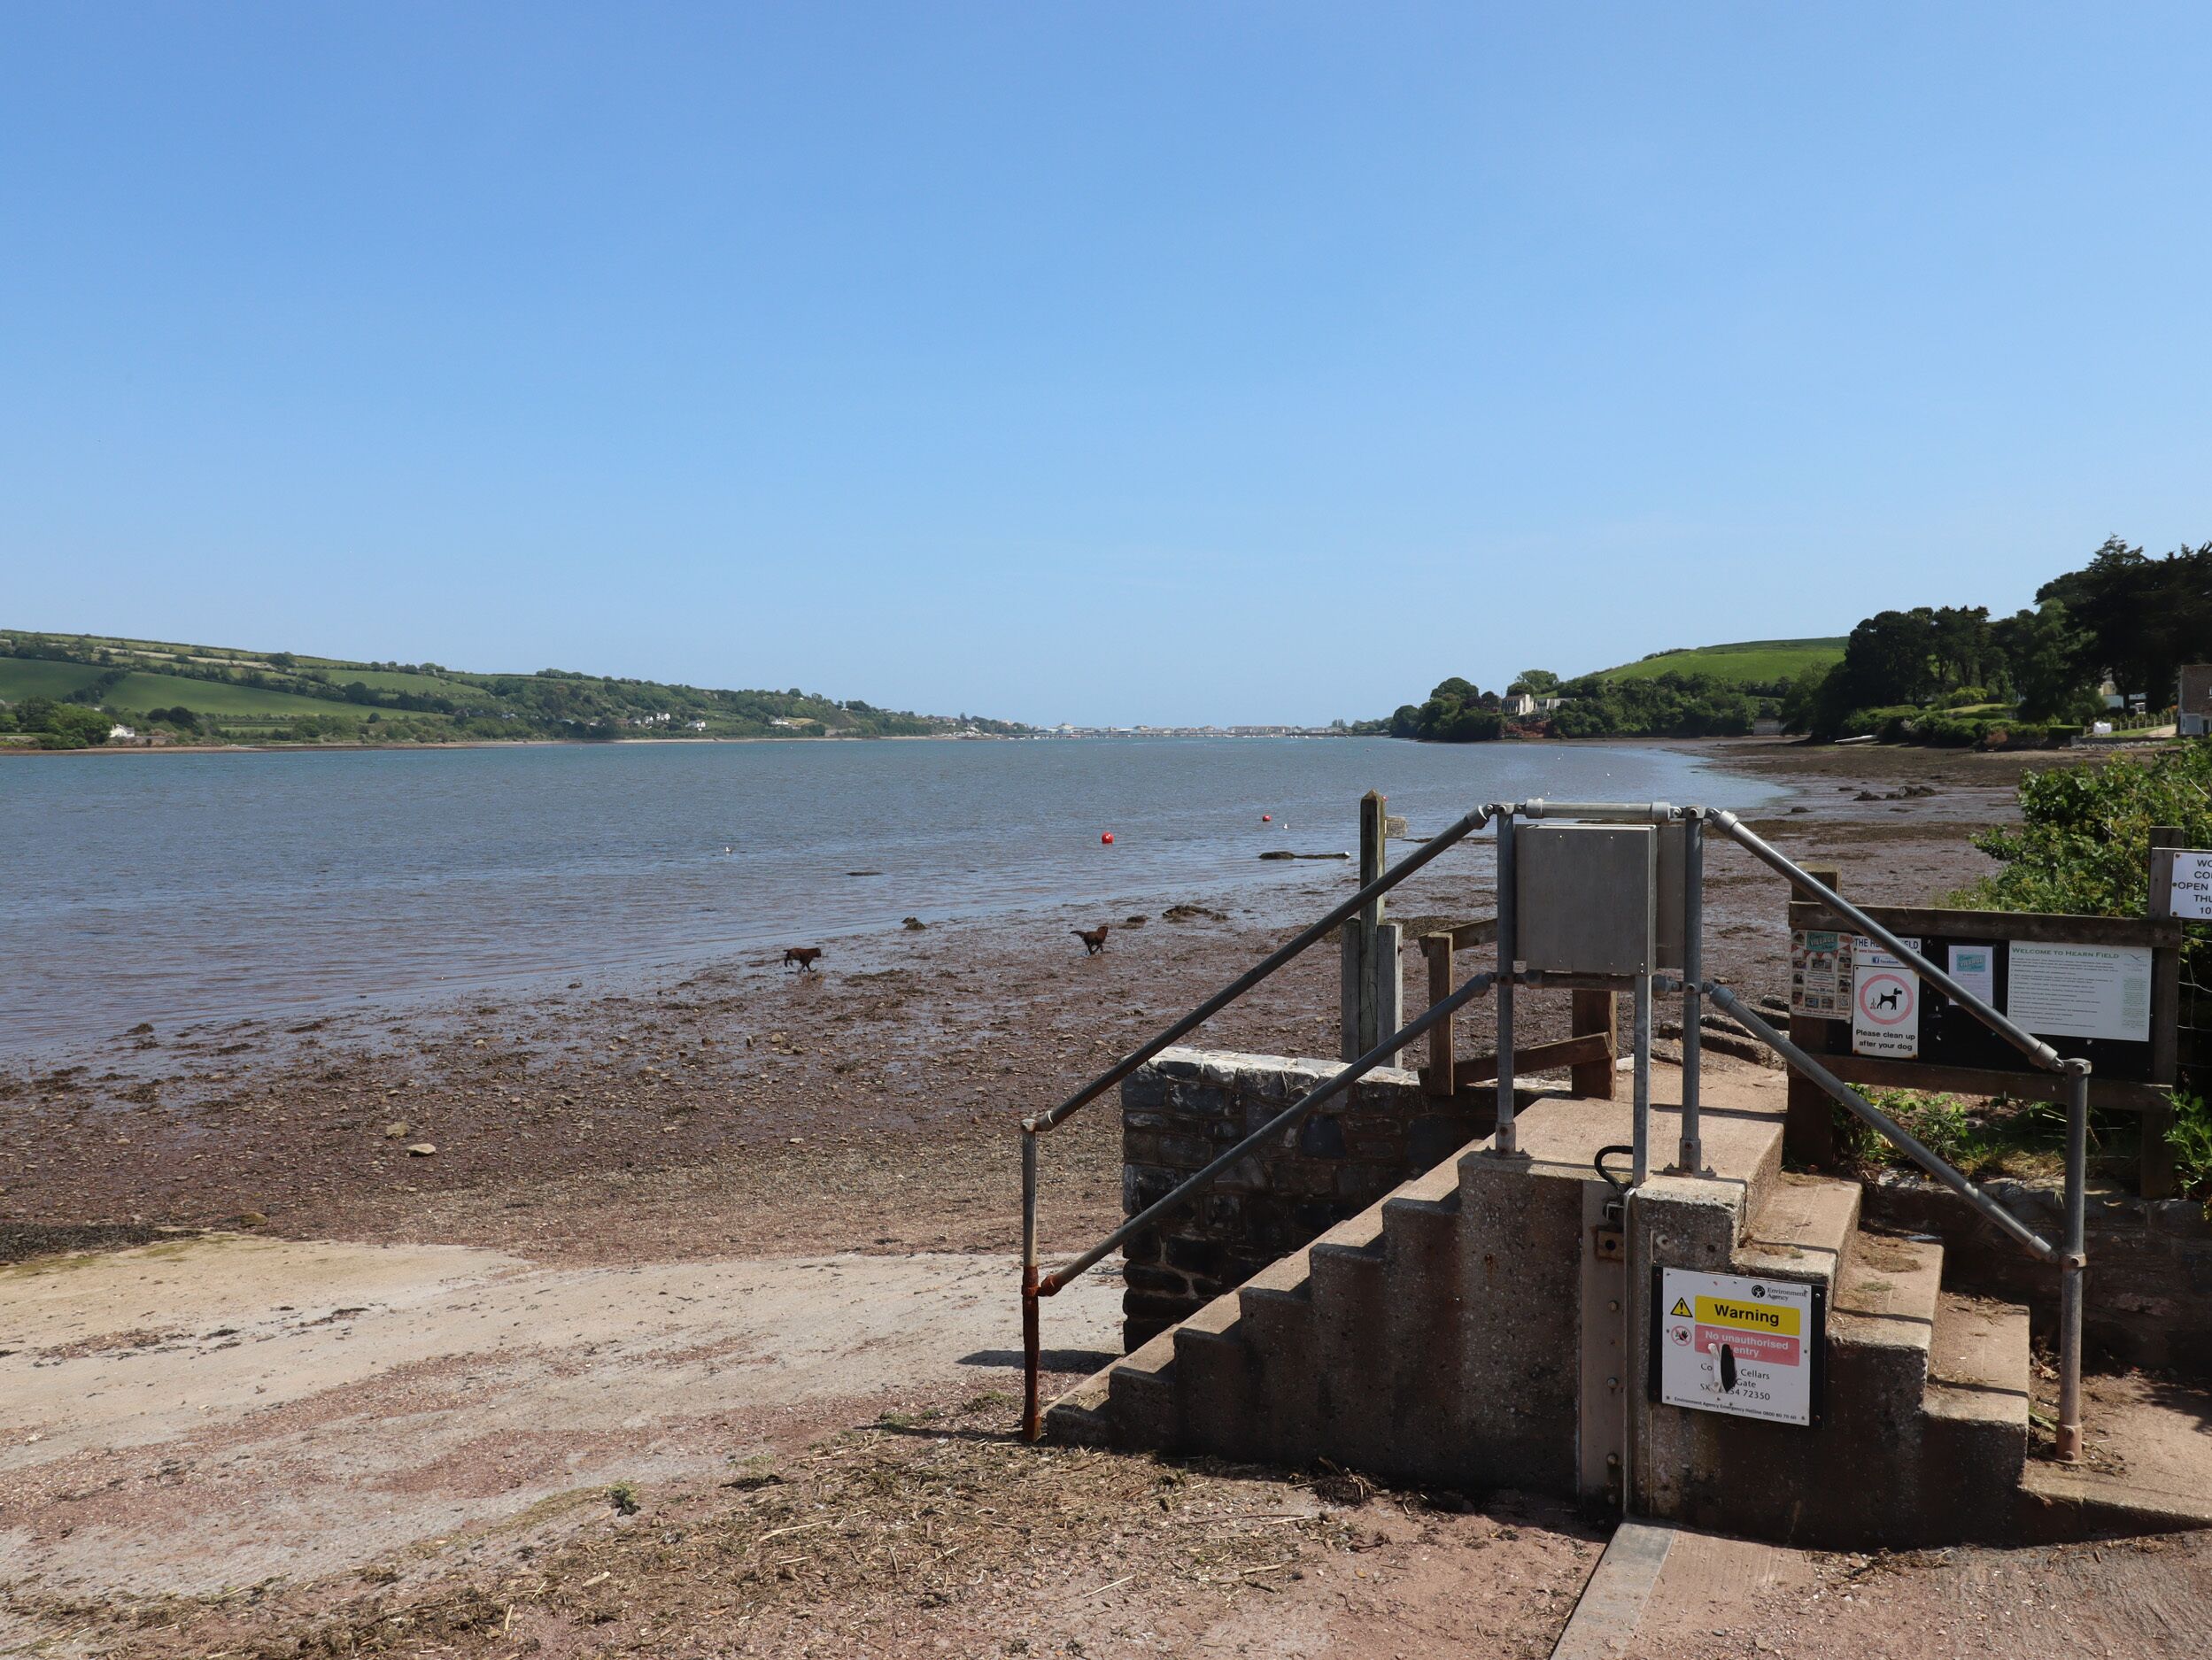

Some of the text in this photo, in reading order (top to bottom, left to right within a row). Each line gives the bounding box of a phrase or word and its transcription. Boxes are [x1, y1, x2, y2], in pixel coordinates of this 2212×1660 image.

[2178, 882, 2208, 891] OPEN
[1855, 938, 1868, 947] THE
[1767, 1287, 1807, 1298] Environment
[1767, 1293, 1789, 1301] Agency
[1714, 1303, 1780, 1326] Warning
[1705, 1331, 1790, 1350] No unauthorised
[1734, 1346, 1760, 1357] entry
[1740, 1369, 1770, 1380] Cellars
[1736, 1378, 1757, 1388] Gate
[1743, 1389, 1771, 1401] 72350
